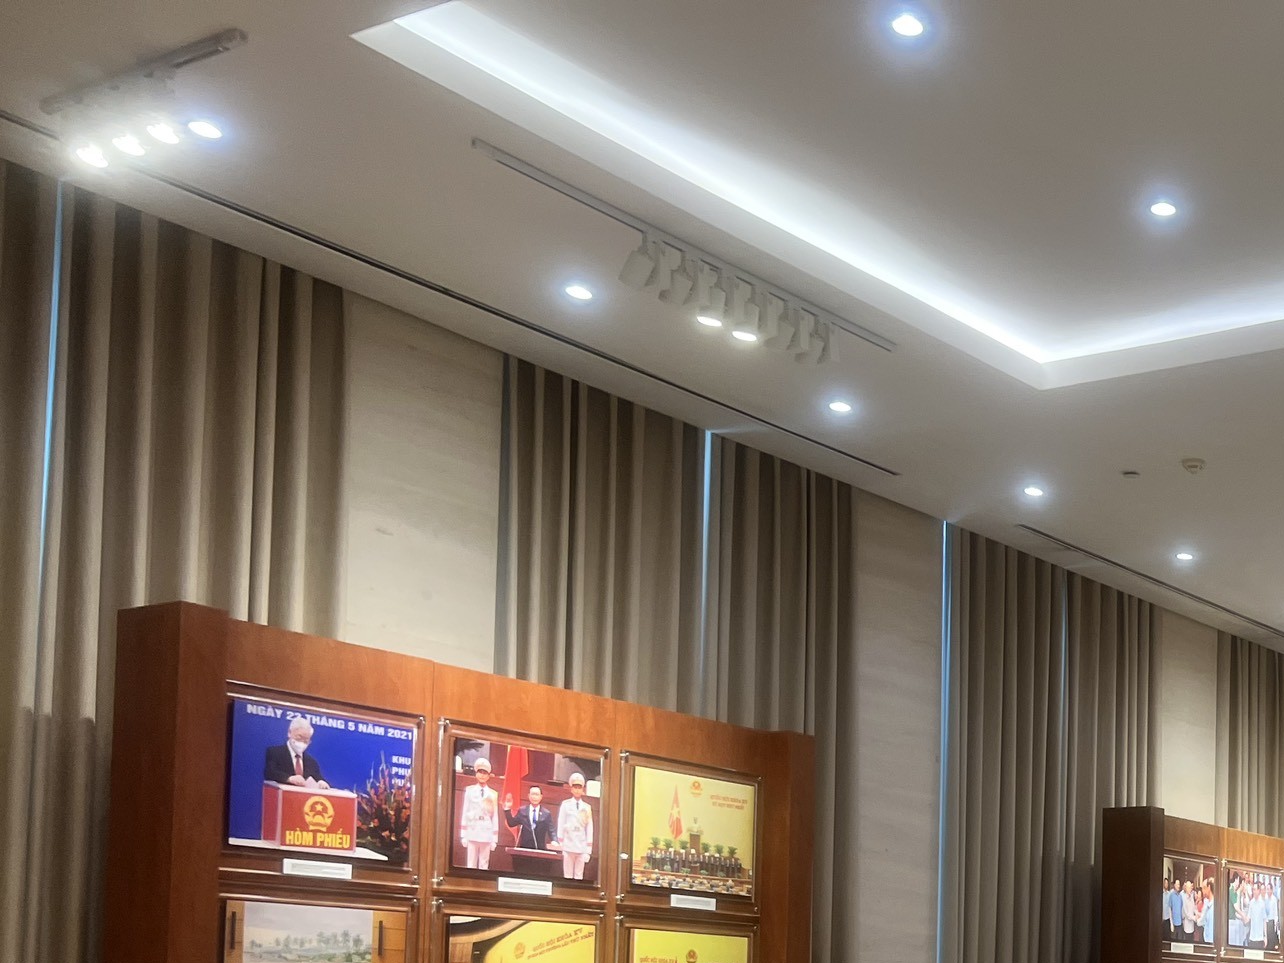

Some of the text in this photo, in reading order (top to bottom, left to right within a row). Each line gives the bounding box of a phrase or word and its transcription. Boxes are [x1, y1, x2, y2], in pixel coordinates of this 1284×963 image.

[247, 703, 283, 719] NGÀY
[304, 713, 345, 730] THÁNG
[348, 721, 356, 732] 5
[358, 723, 385, 736] NĂM
[387, 728, 413, 741] 2021
[392, 755, 411, 765] KHU
[285, 828, 350, 848] HÒM PHIẾU
